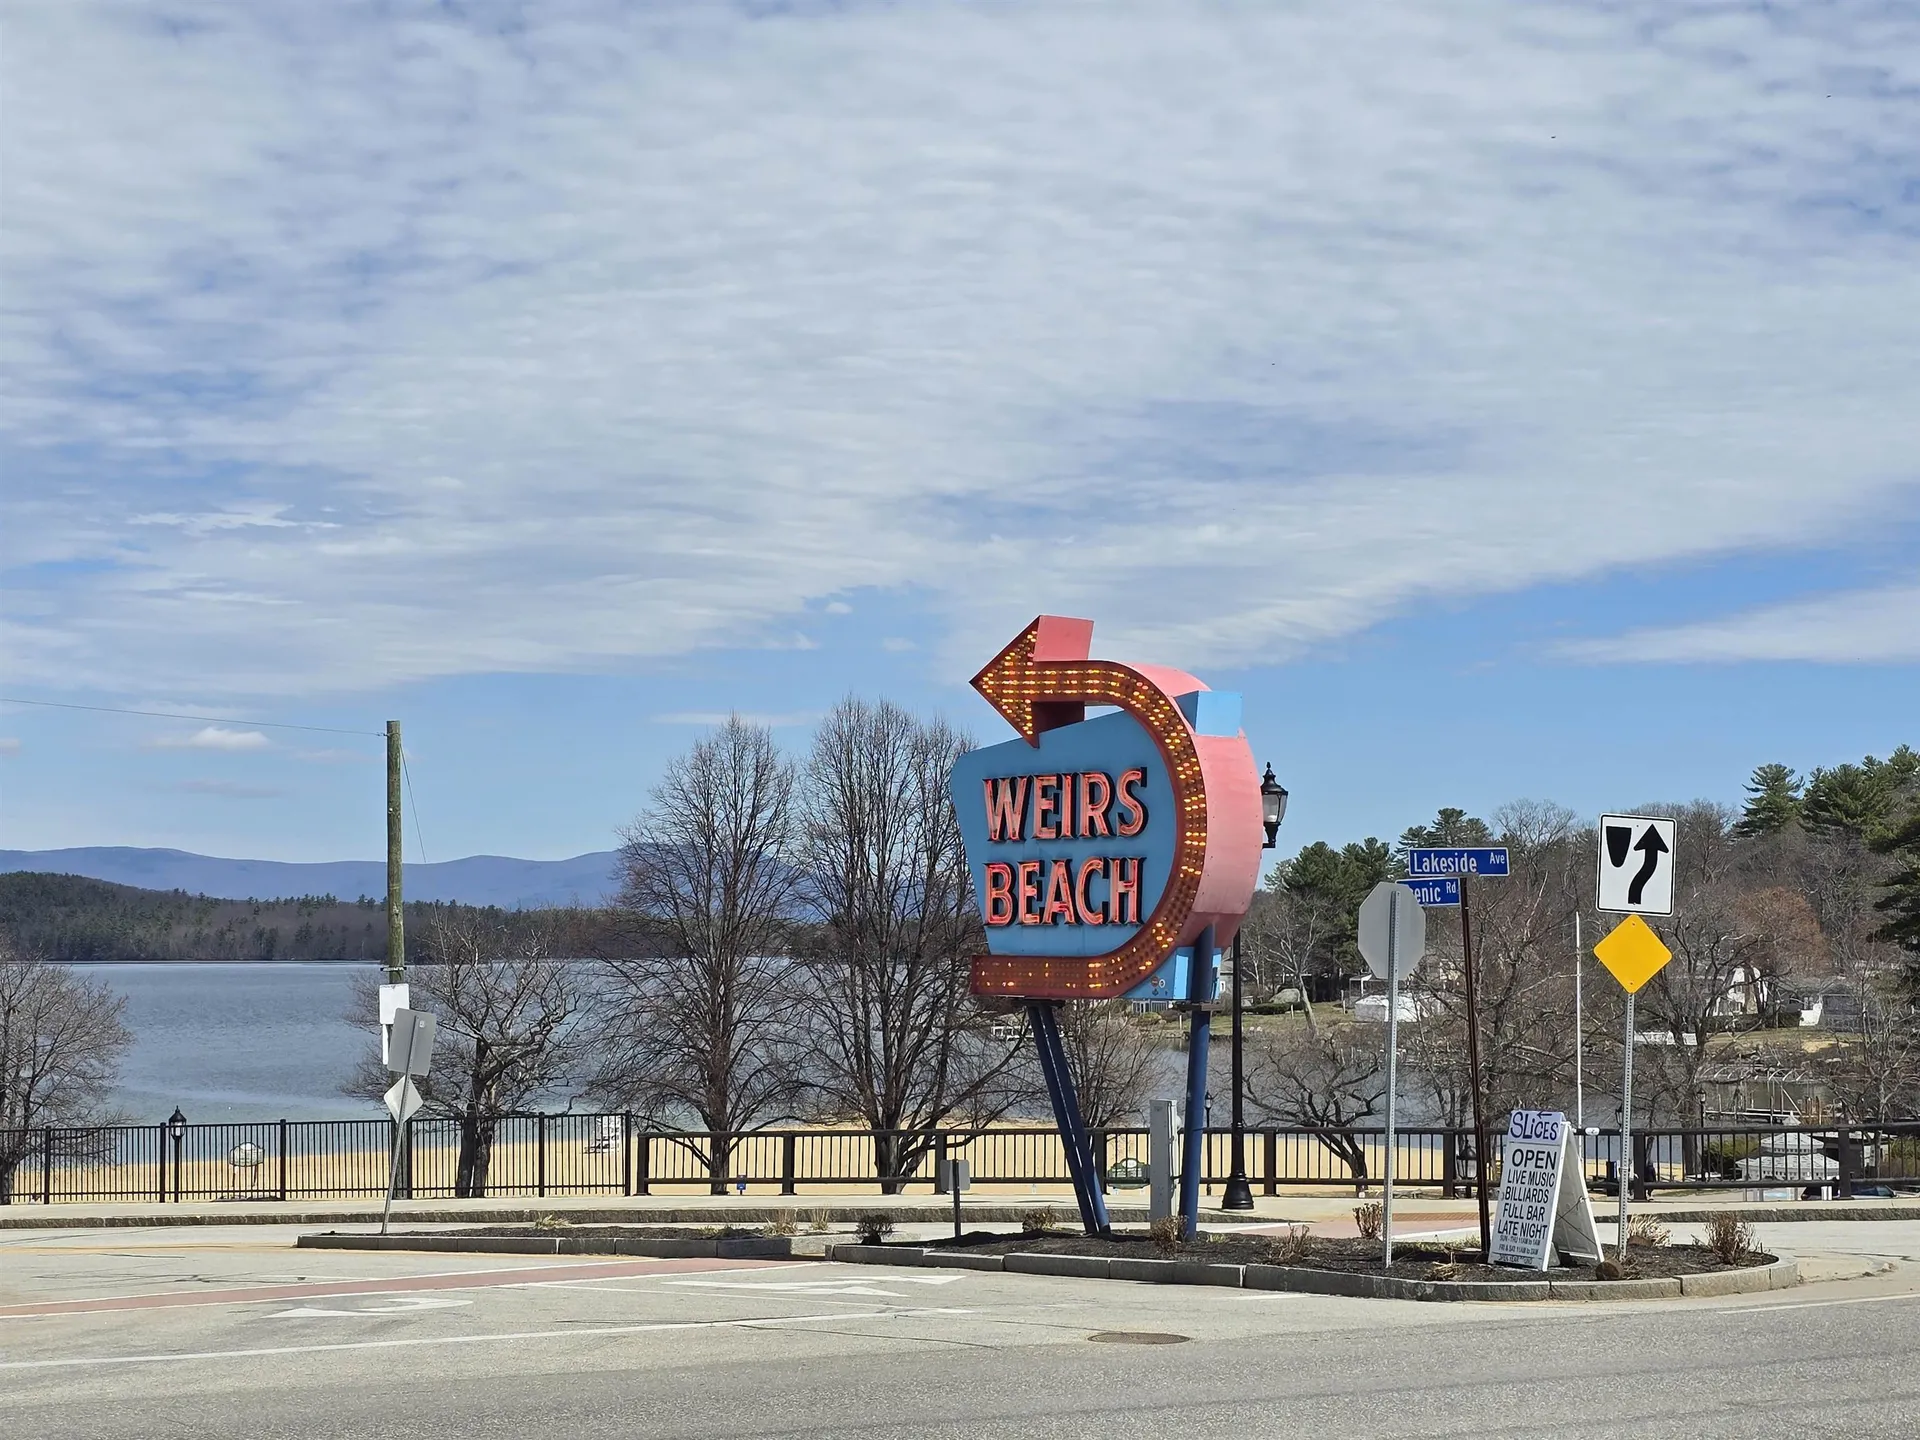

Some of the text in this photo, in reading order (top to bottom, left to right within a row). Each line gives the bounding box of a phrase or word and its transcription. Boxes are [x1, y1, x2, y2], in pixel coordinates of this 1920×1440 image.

[983, 767, 1149, 841] WEIRS
[1413, 852, 1506, 873] Lakeside Ave
[983, 856, 1147, 926] BEACH
[1412, 882, 1457, 903] enic Rd
[1512, 1148, 1557, 1170] OPEN
[1507, 1169, 1555, 1188] LIVE MUSIC
[1505, 1186, 1549, 1204] BILLIARDS
[1503, 1203, 1545, 1222] FULL BAR
[1498, 1219, 1548, 1240] LATE NIGHT
